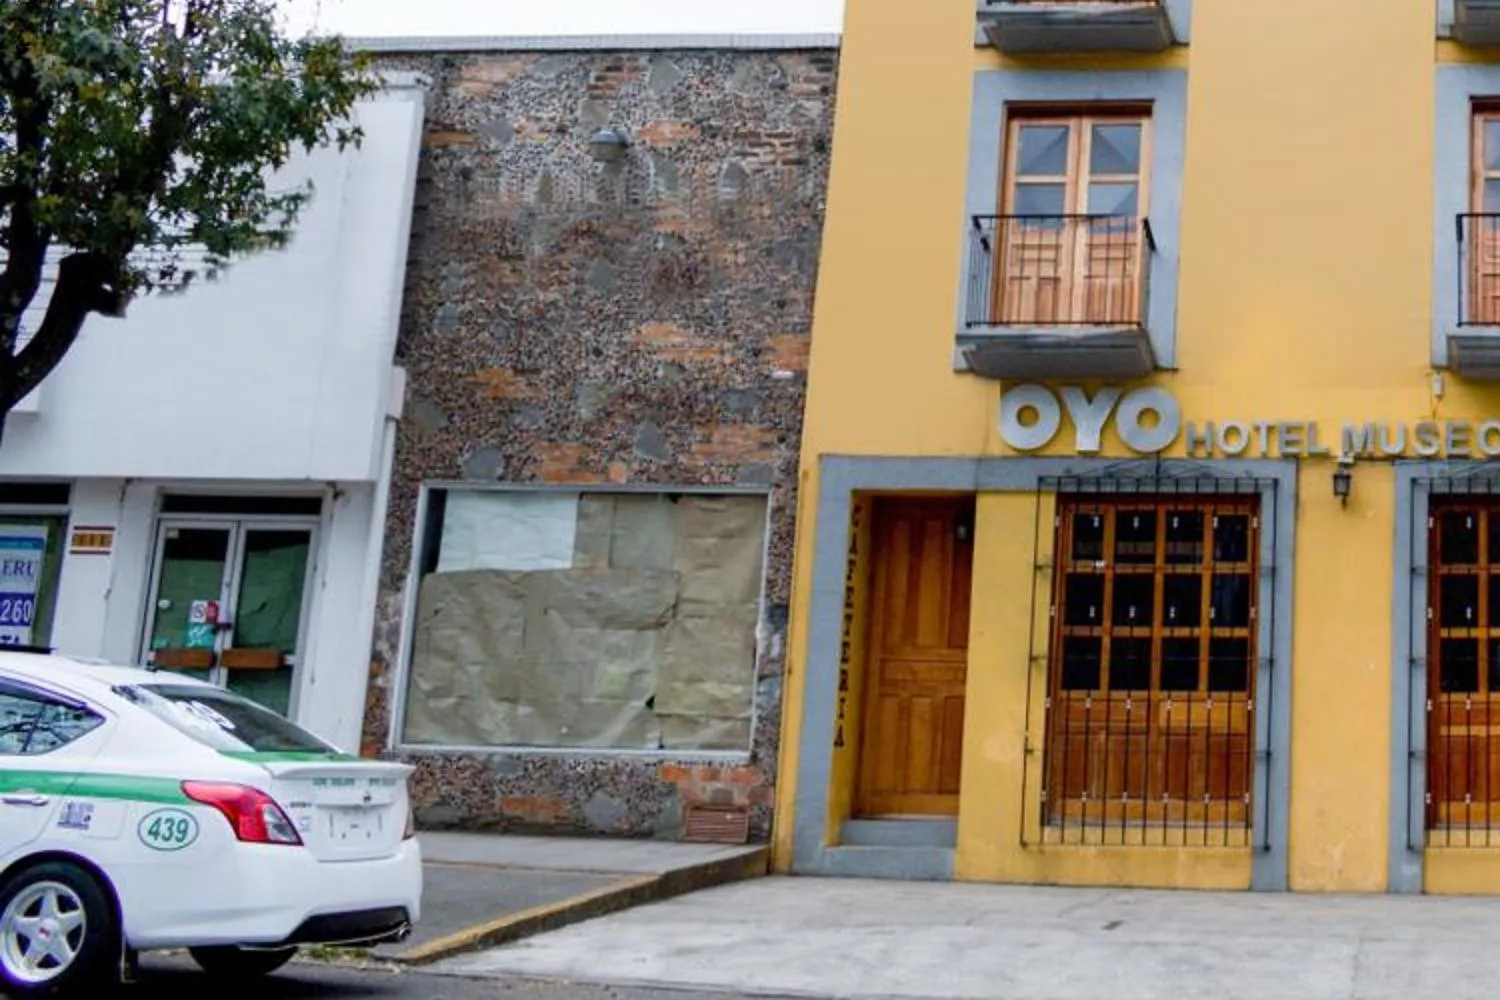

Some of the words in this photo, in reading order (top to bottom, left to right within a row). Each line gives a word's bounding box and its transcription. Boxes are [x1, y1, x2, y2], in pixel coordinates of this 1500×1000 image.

[998, 383, 1181, 453] OYO
[1186, 421, 1330, 457] HOTEL
[147, 816, 190, 843] 439
